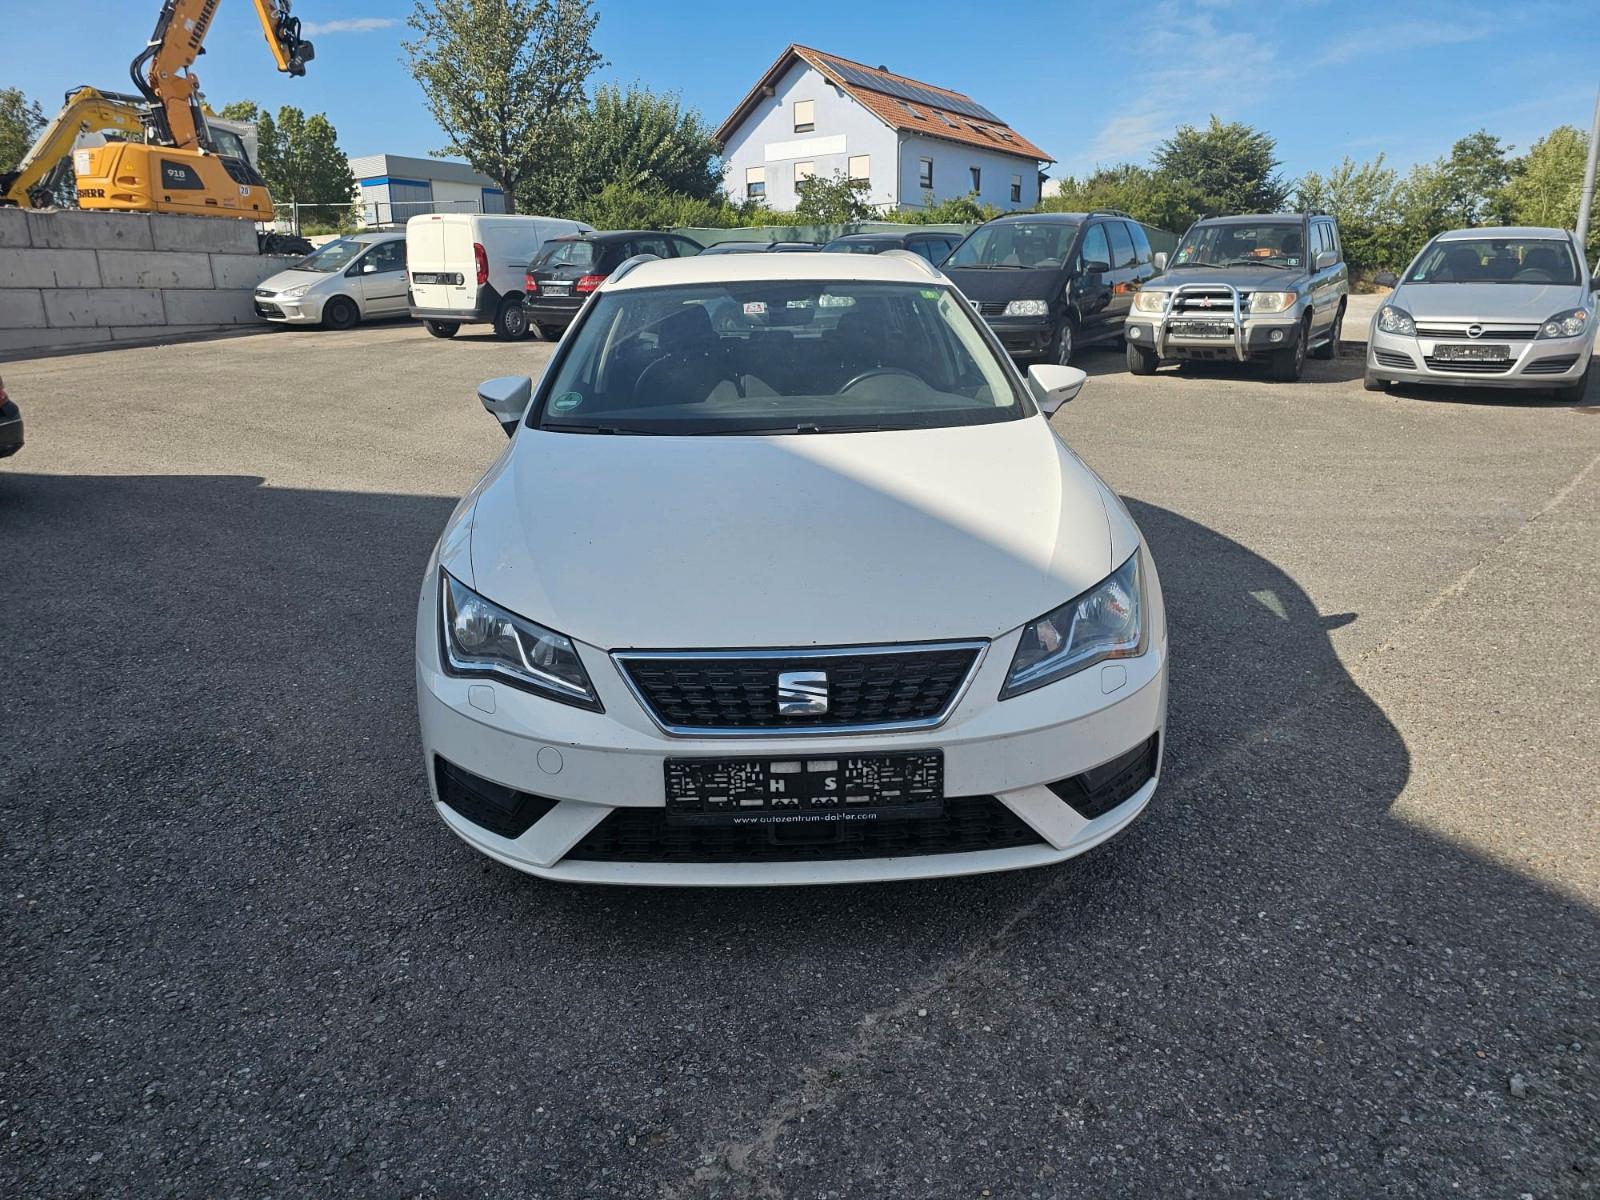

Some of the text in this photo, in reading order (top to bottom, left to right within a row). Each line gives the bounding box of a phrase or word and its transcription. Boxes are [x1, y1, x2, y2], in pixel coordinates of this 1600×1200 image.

[167, 169, 185, 178] 918
[770, 777, 838, 792] H S
